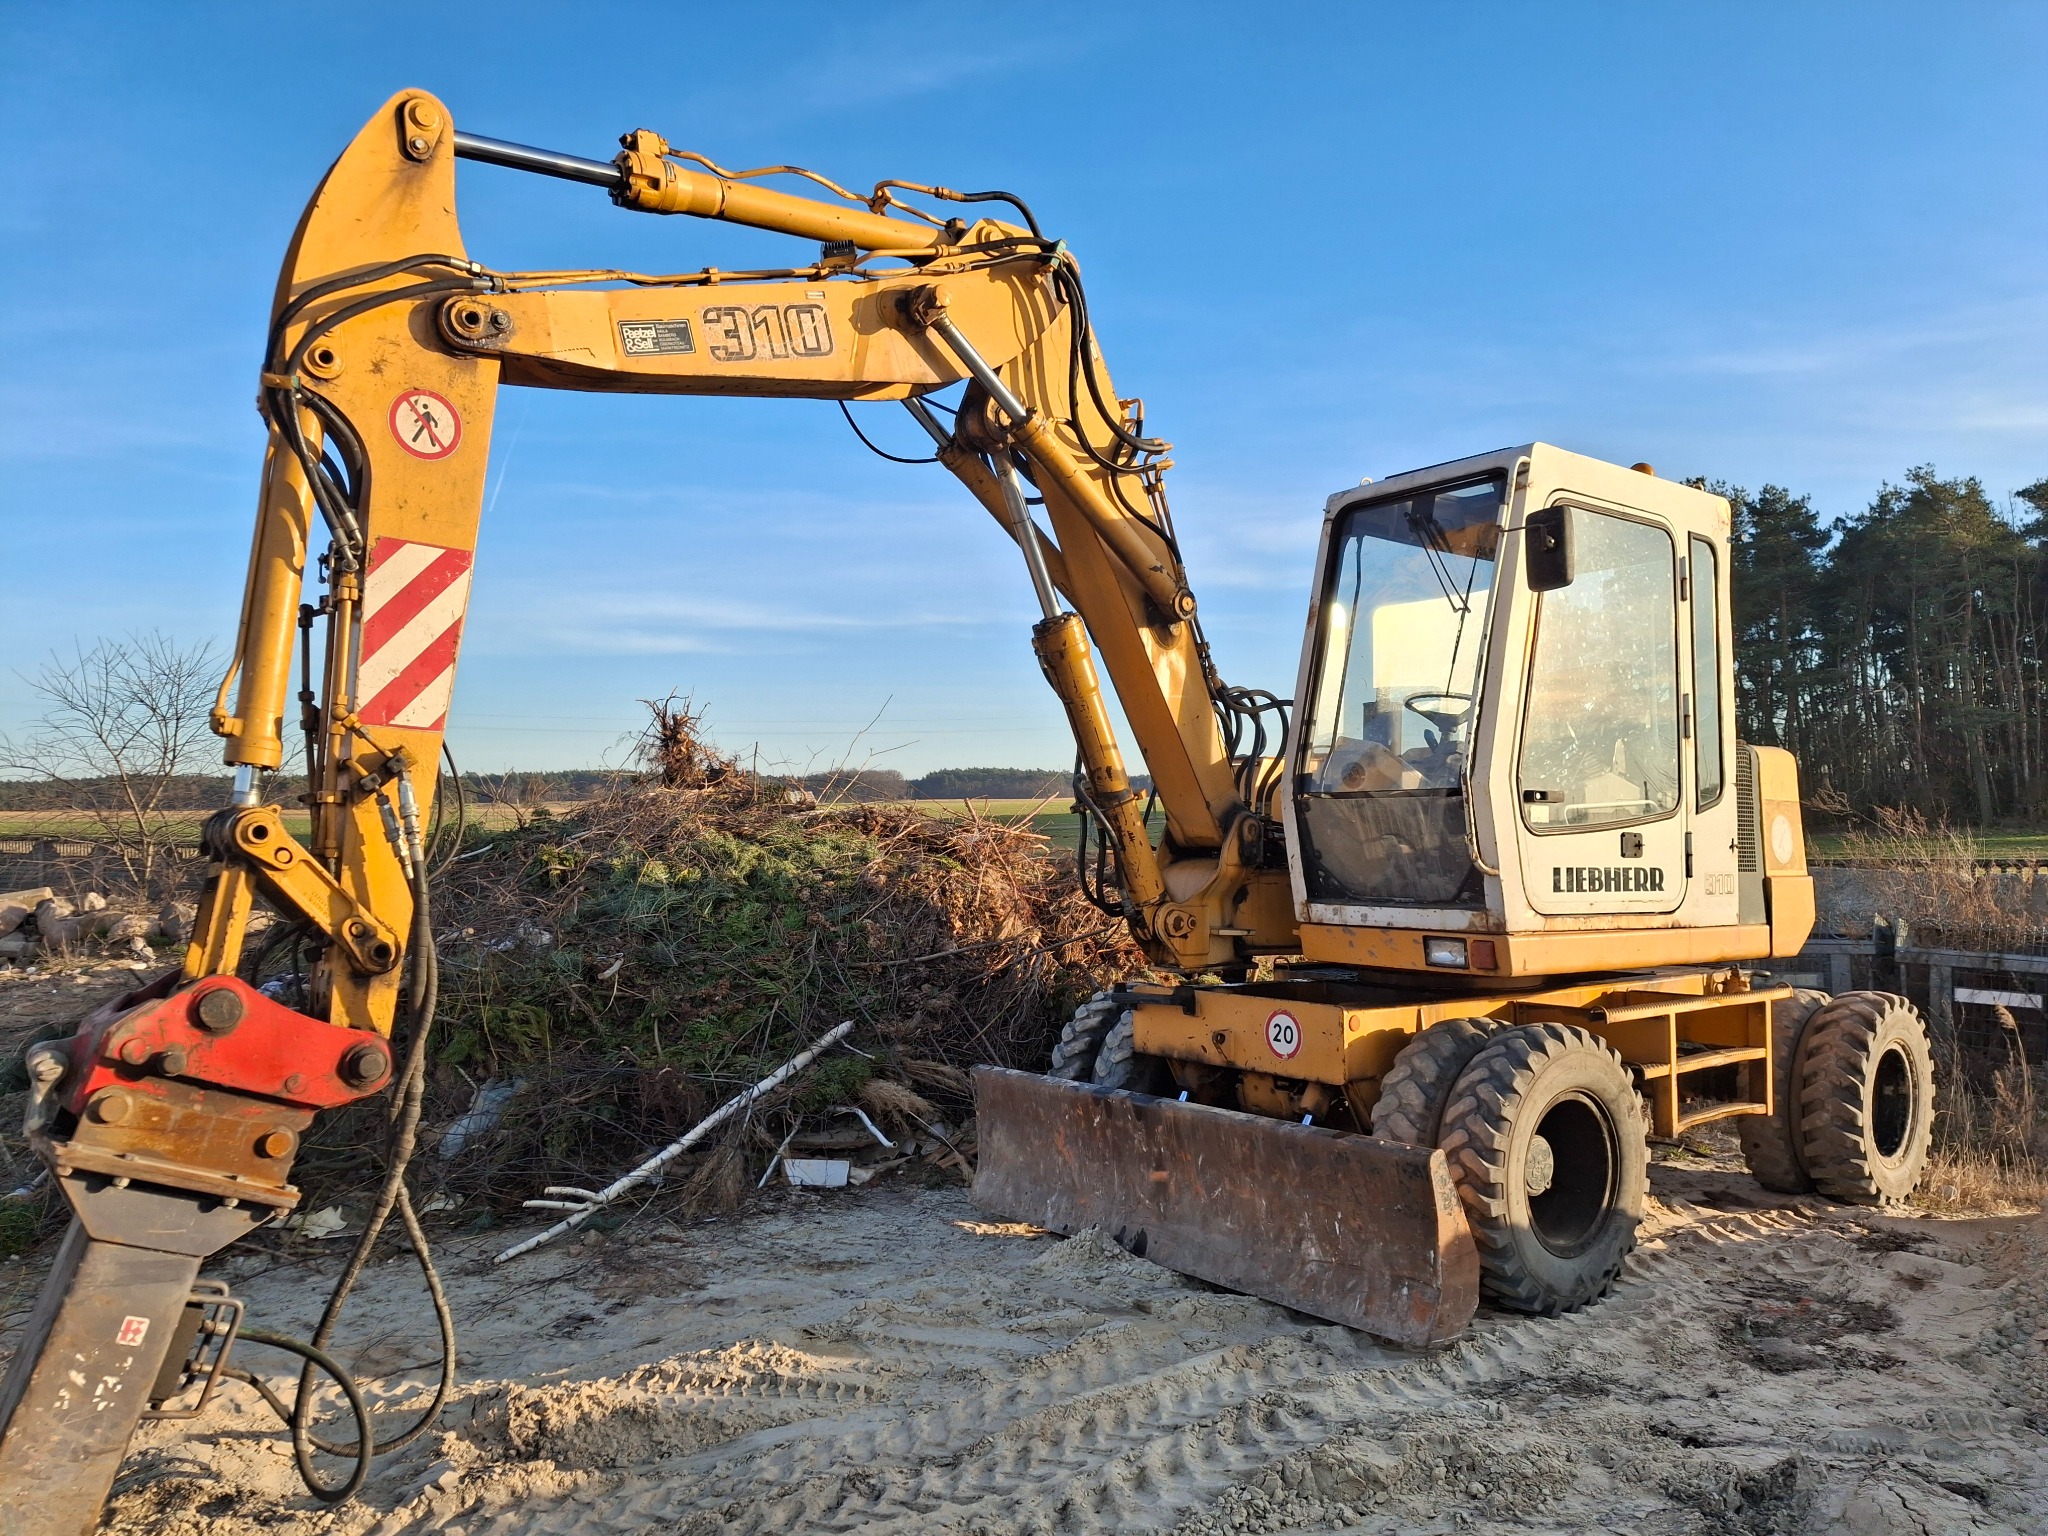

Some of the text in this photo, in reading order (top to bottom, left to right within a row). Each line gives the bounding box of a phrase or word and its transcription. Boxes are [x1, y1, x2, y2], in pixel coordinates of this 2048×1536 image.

[622, 326, 657, 339] Paetzel
[703, 304, 834, 362] 310
[1553, 867, 1665, 893] LIEBHERR
[1705, 873, 1734, 895] 310
[1273, 1023, 1294, 1045] 20
